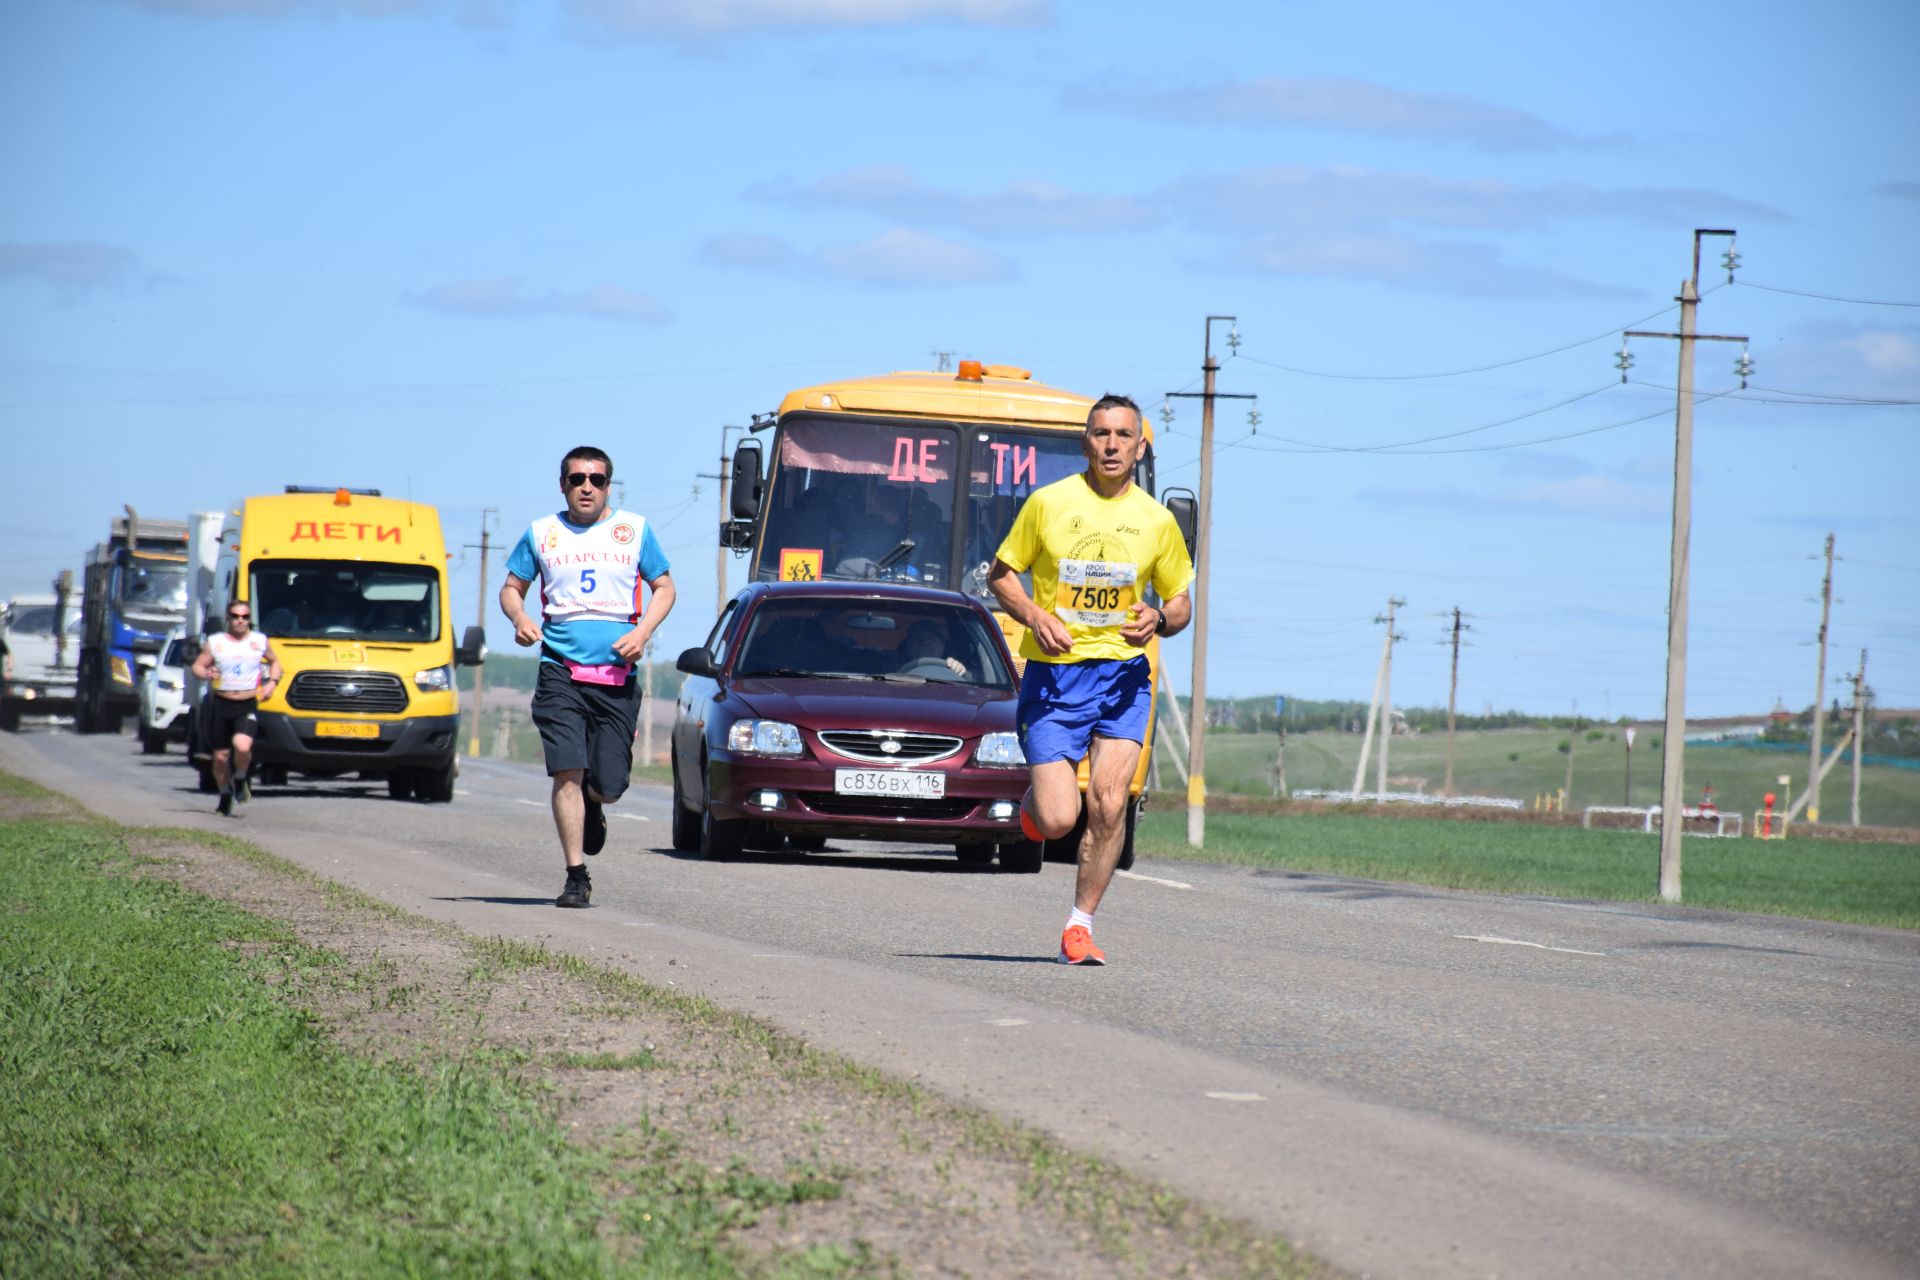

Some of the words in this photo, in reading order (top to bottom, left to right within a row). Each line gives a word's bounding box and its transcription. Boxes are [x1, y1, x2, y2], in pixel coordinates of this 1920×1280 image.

[290, 522, 401, 545] ДЕТИ
[546, 552, 631, 568] ТАТАРСТАН
[580, 569, 597, 593] 5
[1071, 586, 1120, 610] 7503
[915, 774, 940, 788] 116
